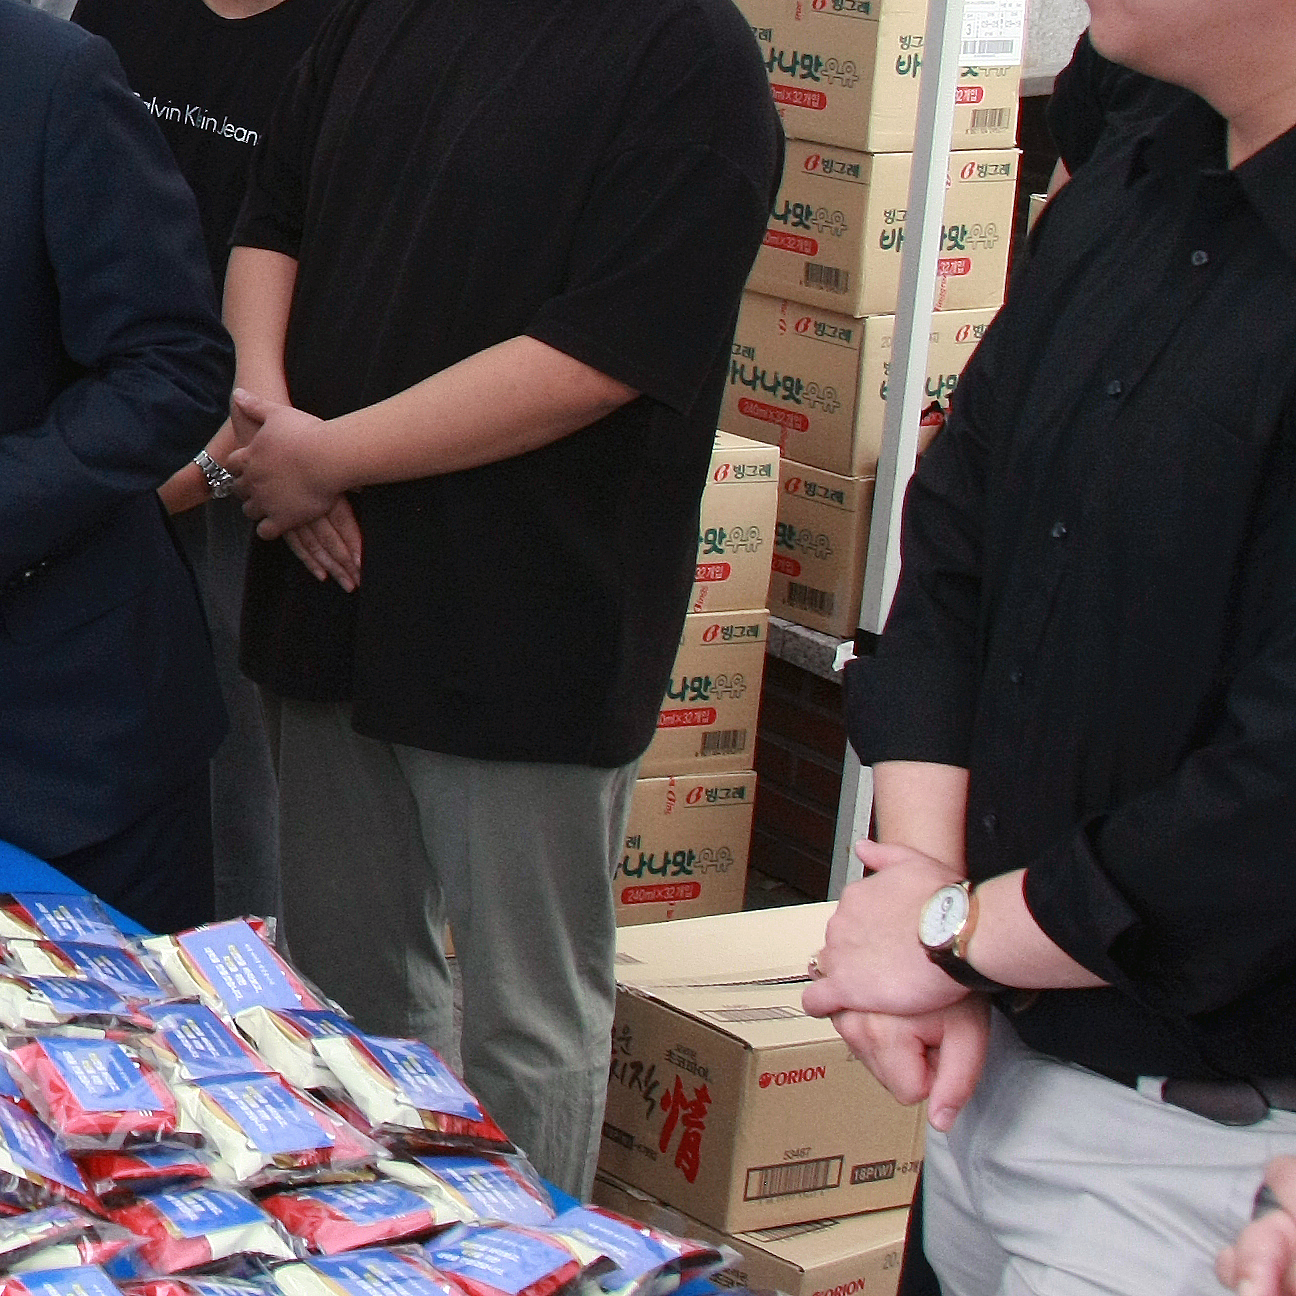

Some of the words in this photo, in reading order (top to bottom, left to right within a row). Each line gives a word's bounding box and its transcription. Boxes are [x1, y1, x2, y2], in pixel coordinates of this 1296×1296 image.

[899, 35, 923, 50] 빙그
[217, 115, 262, 146] Jean
[772, 200, 848, 237] 나맛우유
[883, 209, 908, 224] 빙그
[731, 344, 755, 361] 그레
[733, 463, 771, 479] 빙그레
[804, 481, 844, 504] 빙그레
[701, 526, 762, 554] 맛우유
[721, 624, 759, 641] 빙그레
[667, 673, 746, 702] 나맛우유
[705, 786, 746, 802] 빙그레
[614, 846, 733, 880] 나나맛우유
[774, 1066, 826, 1087] ORION
[659, 1074, 712, 1184] 情
